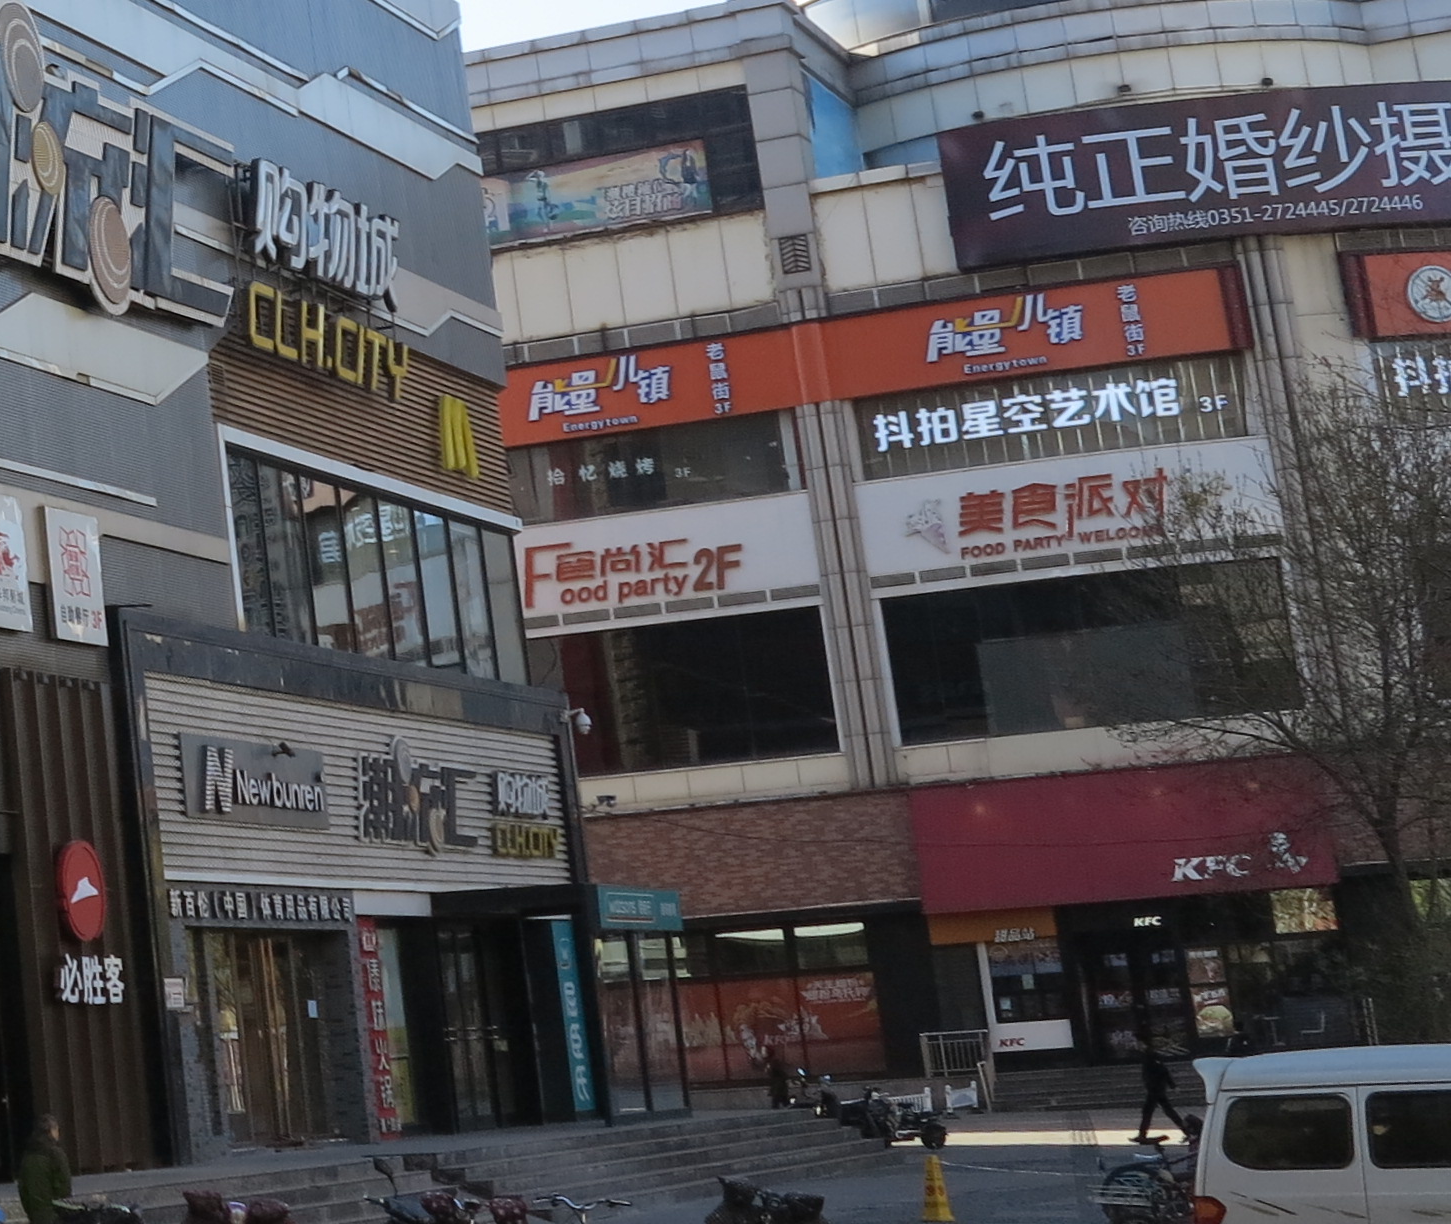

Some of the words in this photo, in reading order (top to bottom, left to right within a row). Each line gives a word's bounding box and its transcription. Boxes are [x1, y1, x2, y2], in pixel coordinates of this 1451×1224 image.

[982, 101, 1451, 222] 纯正婚纱摄
[252, 158, 401, 311] 购物城
[963, 354, 1049, 375] Energytown
[562, 412, 639, 434] Energytown
[873, 377, 1182, 453] 抖拍星空艺术馆
[1198, 394, 1229, 414] 3F
[546, 456, 656, 487] 拾忆烧烤
[958, 467, 1168, 540] 美食派对
[960, 541, 1006, 560] FOOD
[1012, 533, 1064, 553] PARTY
[692, 543, 743, 593] 2F
[617, 569, 690, 606] party
[1172, 854, 1254, 884] KFC
[1133, 914, 1163, 929] KFC
[58, 953, 127, 1006] 必胜客
[998, 1035, 1027, 1050] KFC
